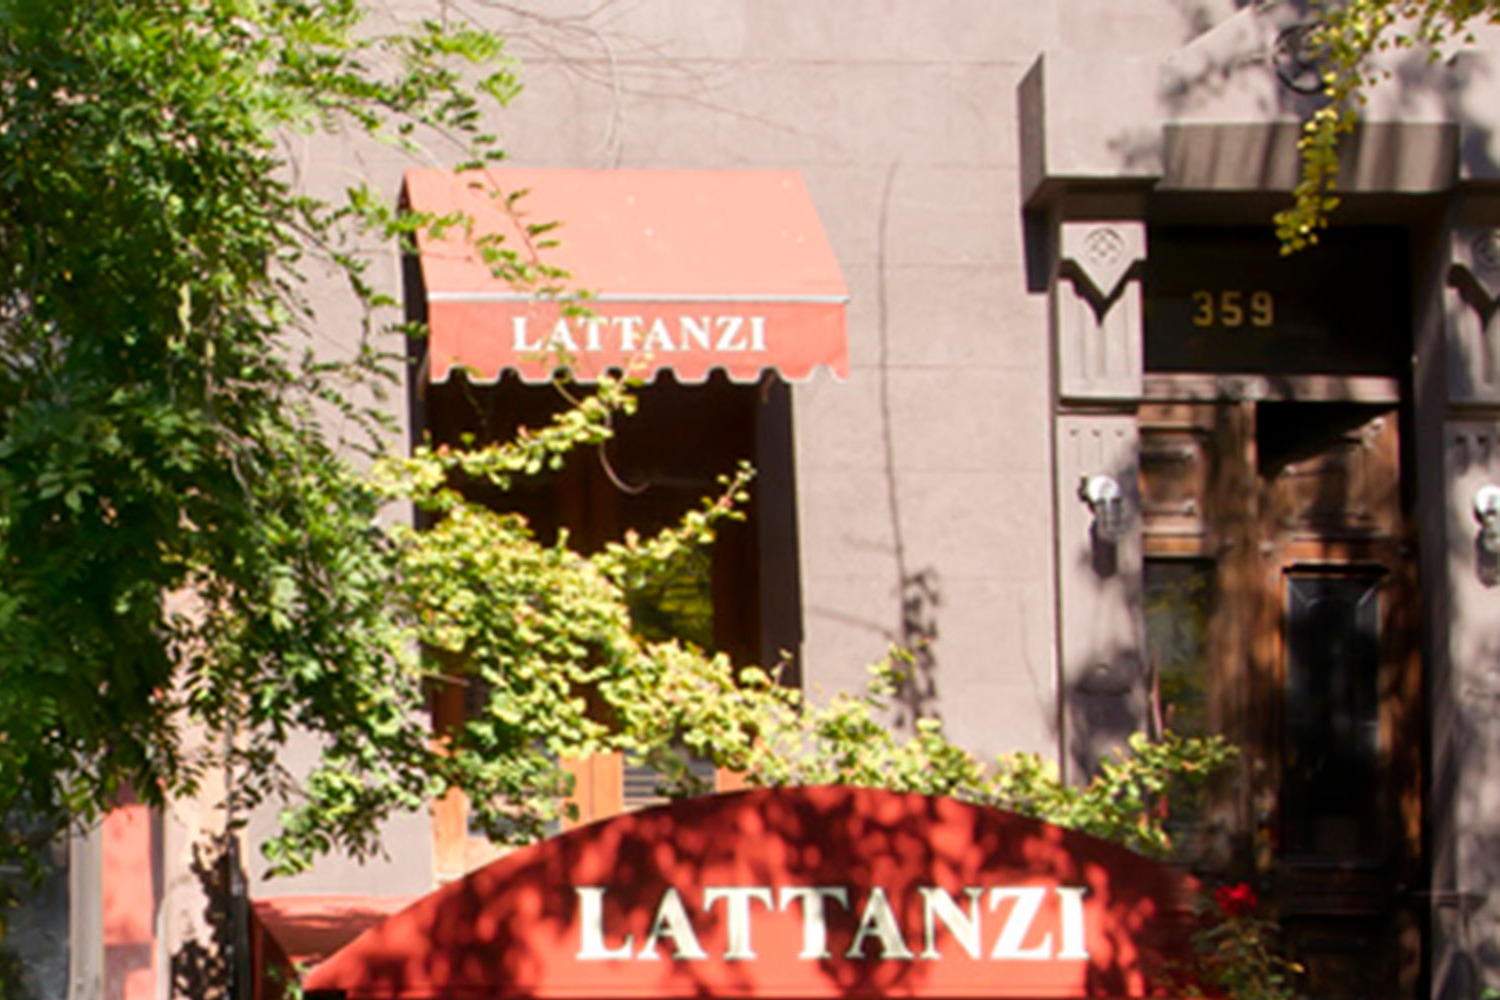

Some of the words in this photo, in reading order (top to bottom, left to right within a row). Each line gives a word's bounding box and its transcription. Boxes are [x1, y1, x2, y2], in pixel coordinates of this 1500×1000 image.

[1192, 290, 1274, 327] 359
[512, 316, 768, 351] LATTANZI
[574, 886, 1089, 961] LATTANZI
